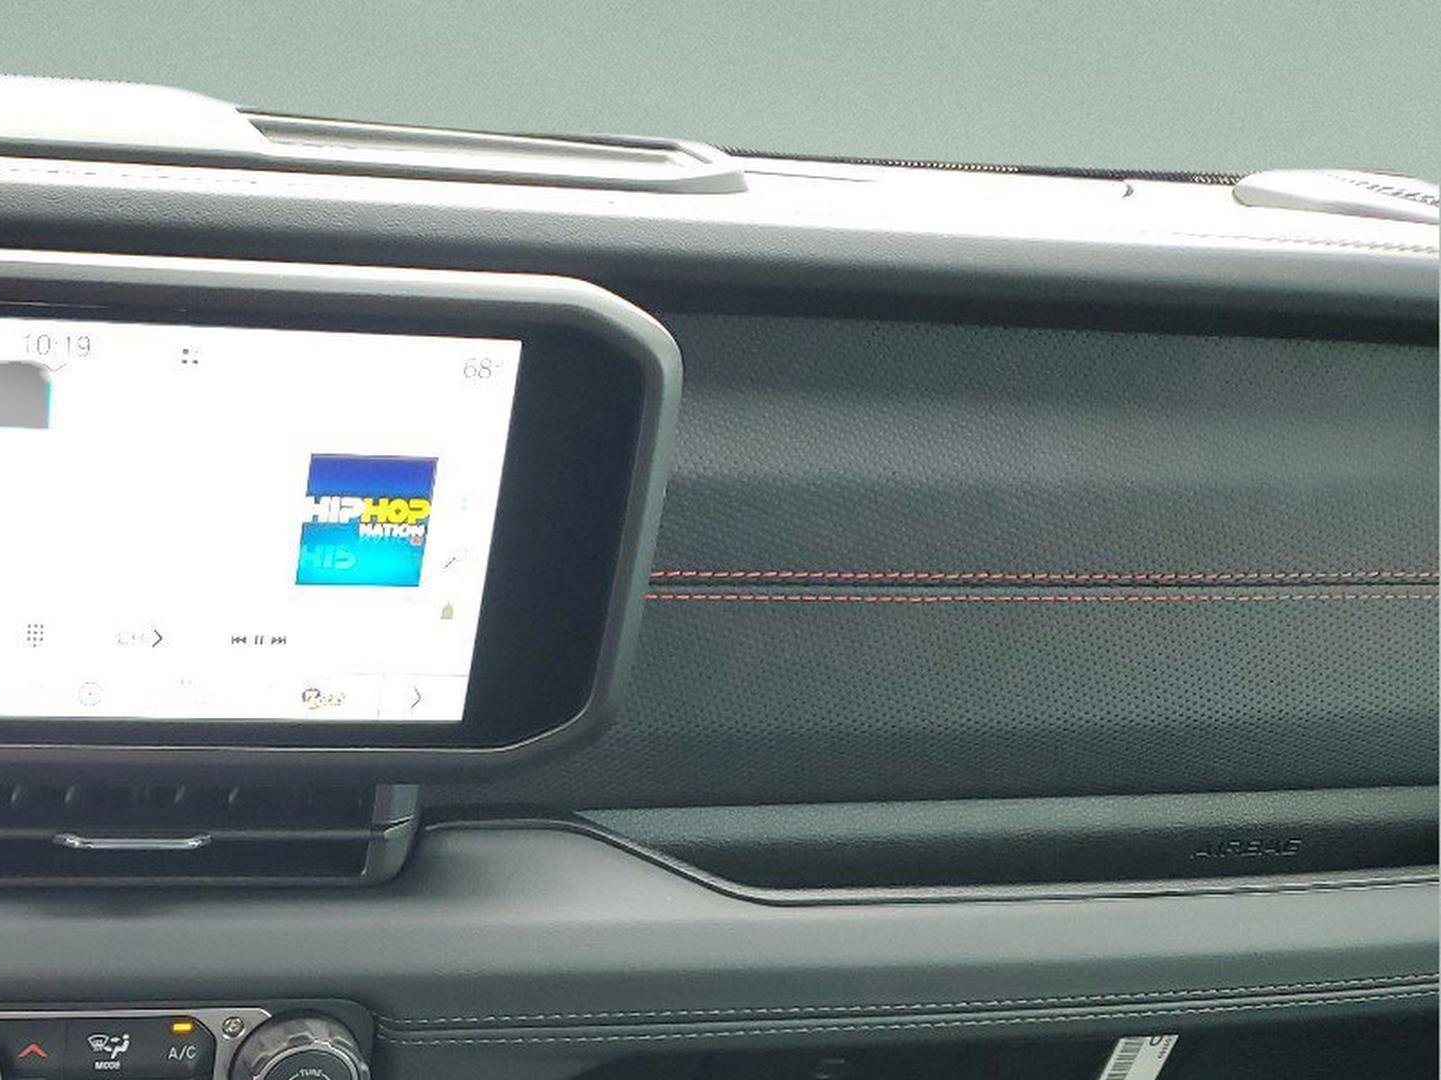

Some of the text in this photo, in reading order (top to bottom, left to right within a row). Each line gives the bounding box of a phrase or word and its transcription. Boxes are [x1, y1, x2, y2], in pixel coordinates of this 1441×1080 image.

[24, 333, 92, 358] 10:19
[359, 524, 426, 540] NATION
[167, 1045, 197, 1062] A/C
